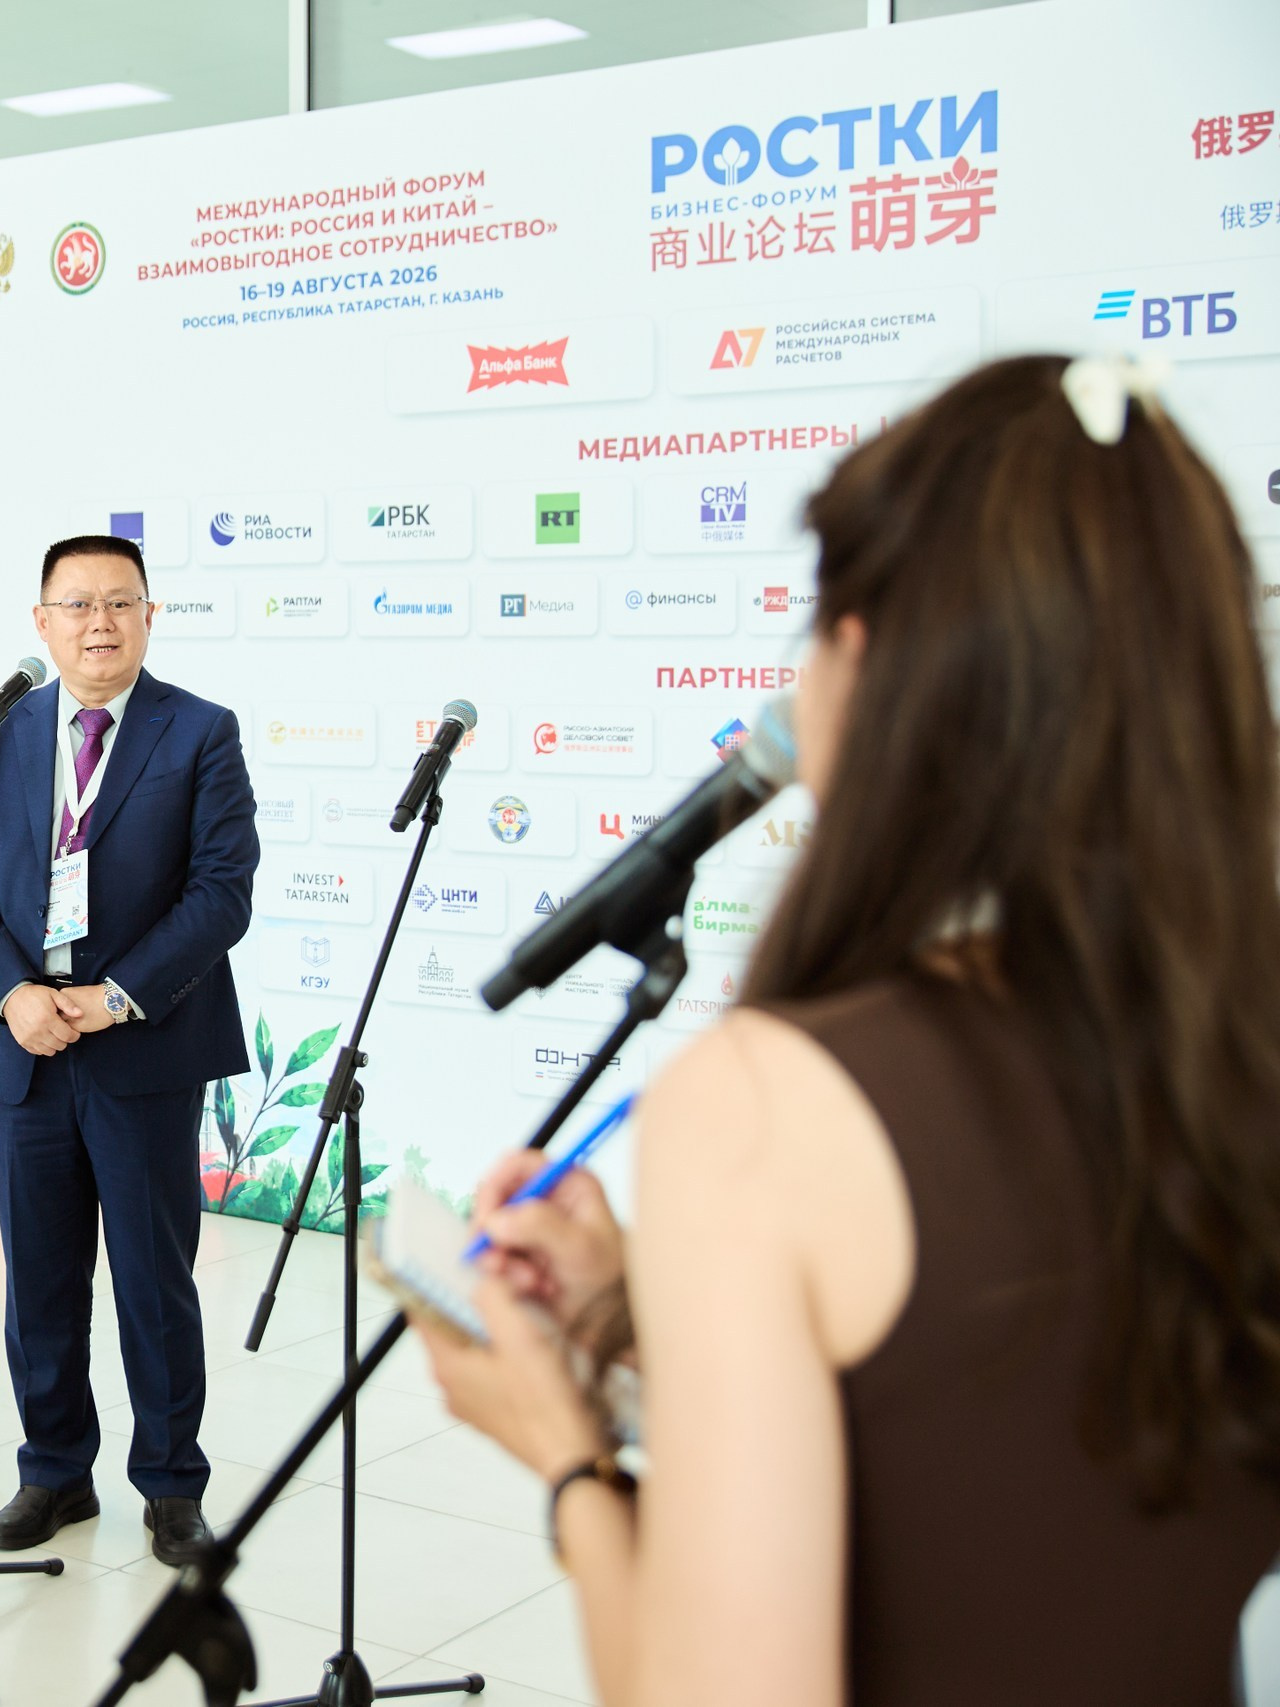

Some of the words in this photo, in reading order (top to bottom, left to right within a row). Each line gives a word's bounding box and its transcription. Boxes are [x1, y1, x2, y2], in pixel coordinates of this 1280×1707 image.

[650, 90, 999, 194] РОСТКИ
[1191, 110, 1280, 160] 俄罗
[196, 176, 396, 223] МЕЖДУНАРОДНЫЙ
[403, 170, 485, 196] ФОРУМ
[651, 185, 838, 220] БИЗНЕС-ФОРУМ
[849, 157, 999, 253] 萌芽
[191, 223, 285, 249] «РОСТКИ:
[291, 211, 375, 238] РОССИЯ
[381, 208, 395, 226] И
[402, 194, 477, 224] КИТАЙ
[137, 243, 333, 281] ВЗАИМОВЫГОДНОЕ
[339, 218, 559, 258] СОТРУДНИЧЕСТВО»
[649, 211, 837, 273] 商业论坛
[291, 270, 384, 297] АВГУСТА
[389, 264, 438, 287] 2026
[182, 313, 240, 329] РОССИЯ,
[242, 304, 333, 324] РЕСПУБЛИКА
[337, 295, 425, 314] ТАТАРСТАН,
[429, 293, 438, 306] Г.
[442, 287, 504, 305] КАЗАНЬ
[1142, 291, 1238, 340] ВТБ
[776, 318, 866, 335] РОССИЙСКАЯ
[870, 312, 937, 328] СИСТЕМА
[776, 330, 900, 350] МЕЖДУНАРОДНЫХ
[479, 357, 522, 377] Альфа
[524, 355, 557, 370] Банк
[776, 351, 843, 365] РАСЧЕТОВ
[578, 424, 859, 462] МЕДИАПАРТНЕРЫ
[701, 481, 747, 503] CRM
[244, 514, 271, 526] РИА
[387, 504, 430, 527] РБК
[540, 509, 580, 527] RT
[710, 504, 737, 522] TV
[245, 526, 312, 540] НОВОСТИ
[386, 529, 435, 539] ТАТАРСТАН
[504, 598, 523, 614] РГ
[529, 599, 575, 613] Медиа
[647, 592, 716, 608] финансы
[657, 667, 807, 690] ПАРТНЕР
[293, 872, 335, 886] INVEST
[284, 888, 349, 904] TATARSTAN
[441, 888, 478, 903] ЦНТИ
[47, 929, 83, 945] PARTICIPANT
[300, 975, 331, 989] КГЭУ
